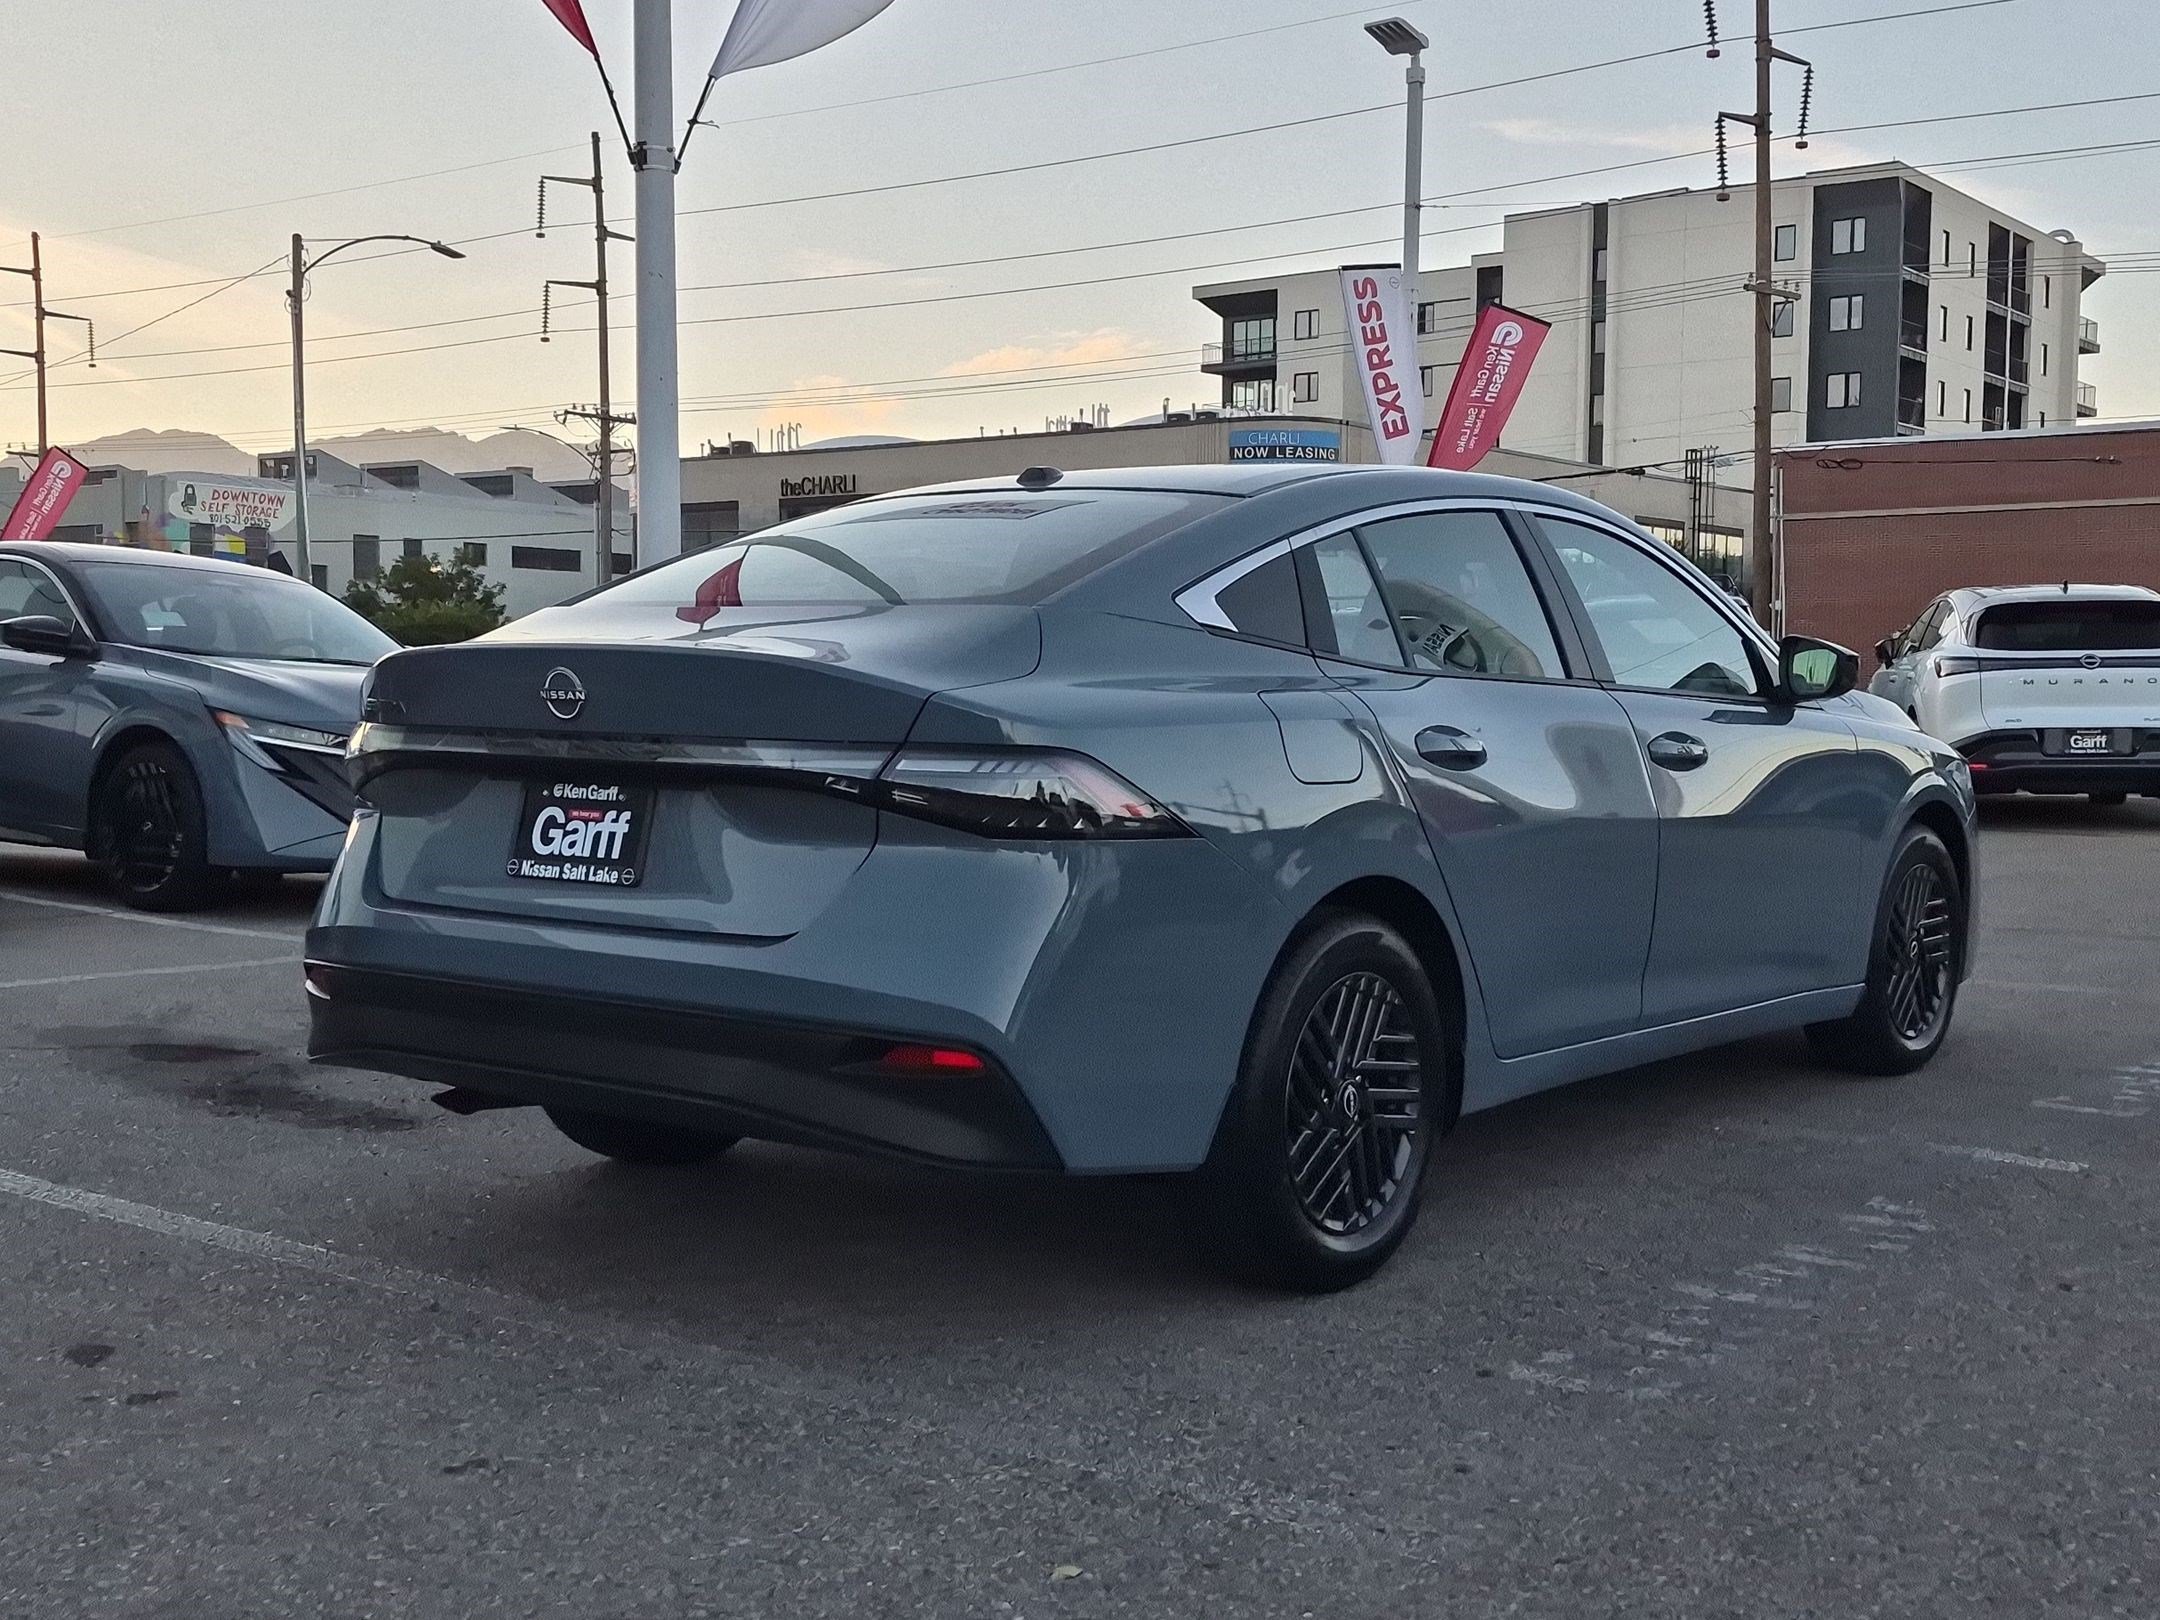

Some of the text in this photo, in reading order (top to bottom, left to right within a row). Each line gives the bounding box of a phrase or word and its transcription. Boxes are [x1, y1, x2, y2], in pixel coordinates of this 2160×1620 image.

[1353, 276, 1410, 440] EXPRESS
[1248, 431, 1300, 445] CHARLI
[1234, 447, 1336, 460] NOW LEASING
[780, 474, 856, 496] theCHARLI
[211, 489, 286, 508] DOWNTOWN
[200, 501, 280, 519] SELF STORAGE
[2023, 677, 2158, 686] MURANO
[540, 690, 586, 700] NISSAN
[2070, 735, 2107, 748] Garff
[563, 784, 618, 801] Ken Garff
[532, 806, 631, 859] Garff
[521, 860, 618, 884] Nissan Salt Lake
